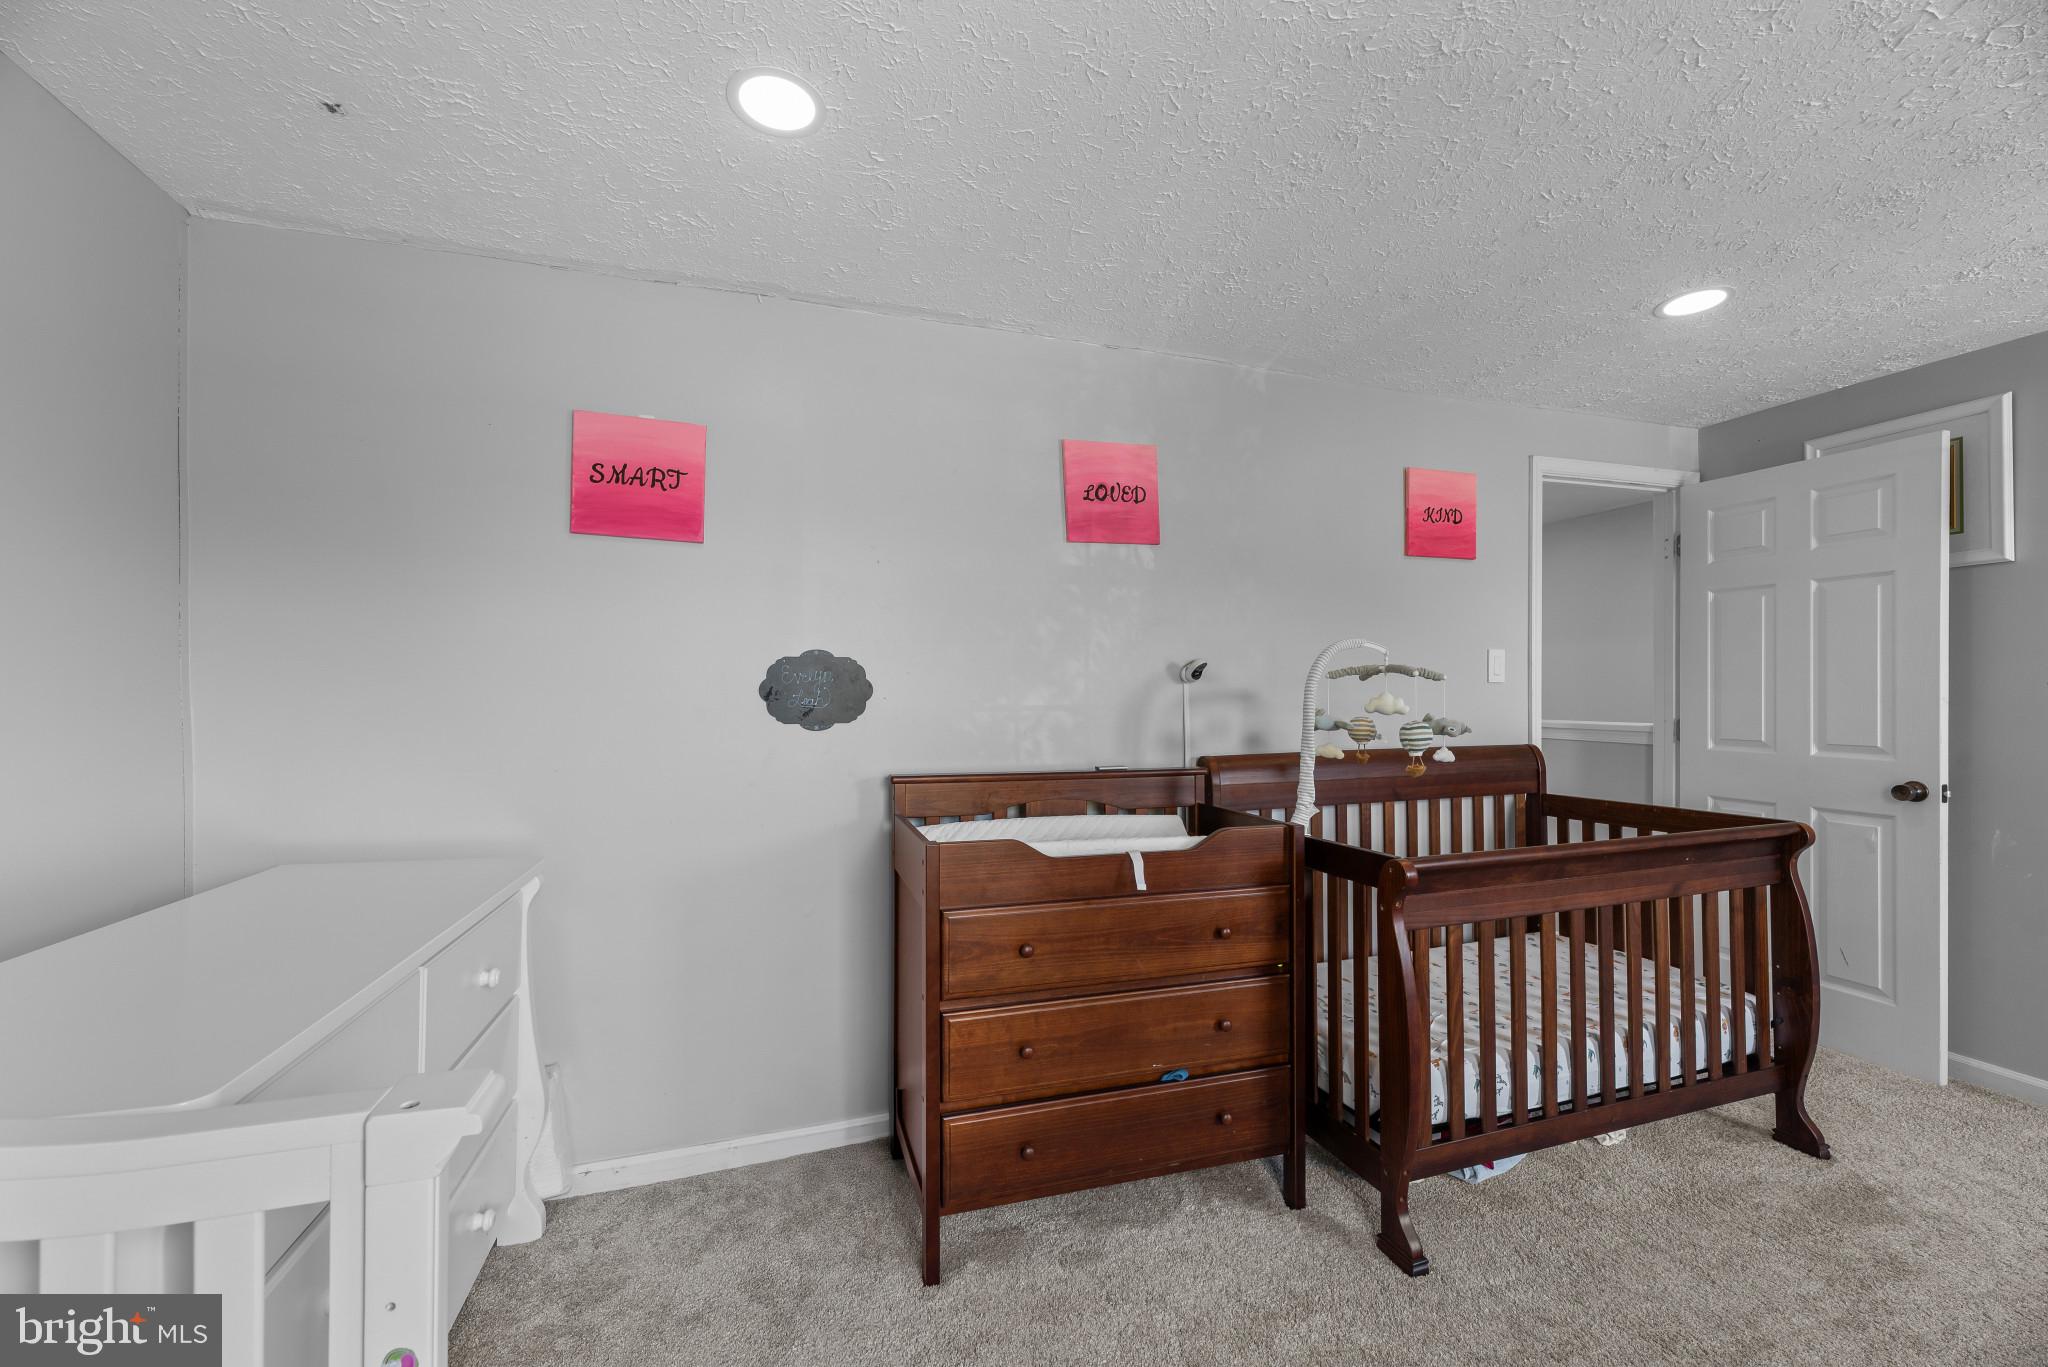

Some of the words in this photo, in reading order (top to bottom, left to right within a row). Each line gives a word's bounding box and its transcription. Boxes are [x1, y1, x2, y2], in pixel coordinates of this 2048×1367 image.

[589, 462, 689, 491] SMART
[1082, 482, 1147, 504] LOVED
[1422, 506, 1463, 525] KIND
